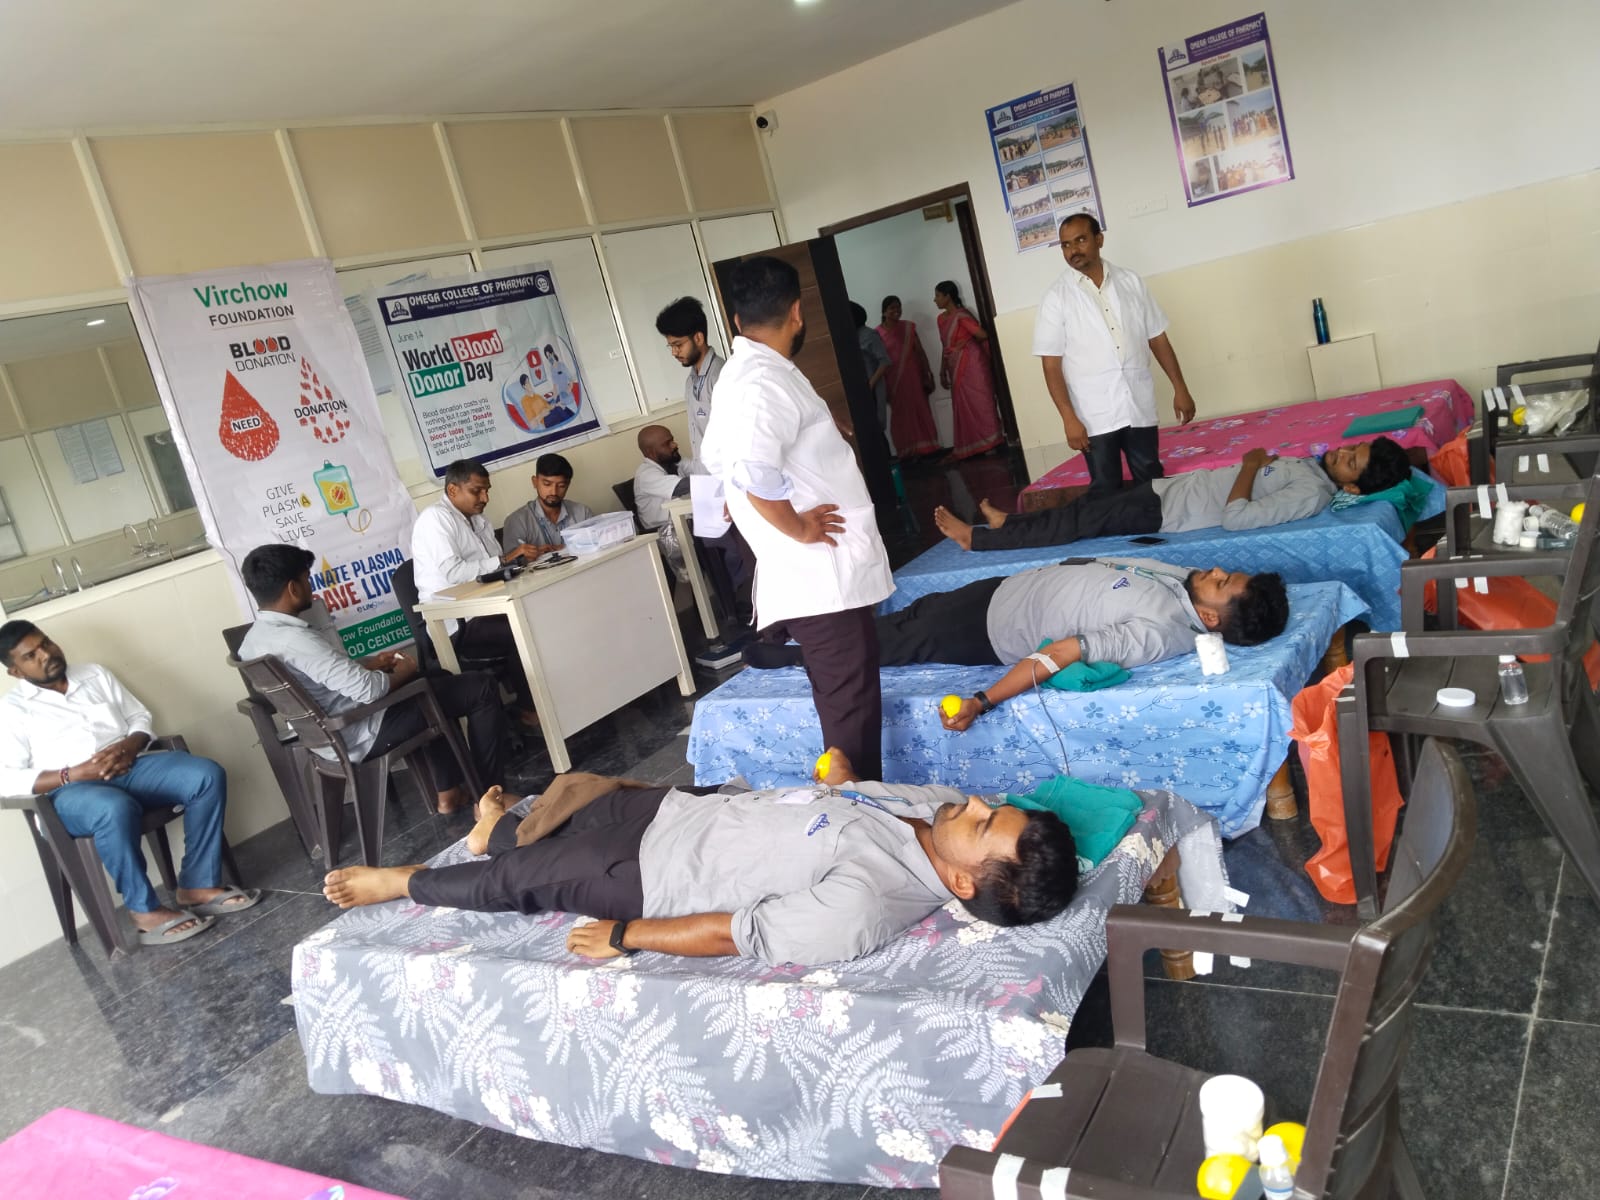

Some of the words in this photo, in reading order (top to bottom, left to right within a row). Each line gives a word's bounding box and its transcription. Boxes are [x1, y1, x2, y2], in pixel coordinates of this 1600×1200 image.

[193, 281, 288, 308] Virchow
[409, 292, 440, 306] OMEGA
[442, 286, 480, 300] COLLEGE
[482, 283, 493, 293] OF
[496, 276, 534, 291] PHARMACY
[209, 305, 294, 326] FOUNDATION
[398, 332, 414, 343] June
[415, 330, 424, 339] 14
[230, 336, 291, 359] BLOOD
[402, 342, 454, 371] World
[454, 333, 502, 362] Blood
[235, 352, 296, 372] DONATION
[410, 366, 462, 396] Donor
[465, 360, 494, 382] Day
[294, 400, 348, 419] DONATION
[422, 410, 438, 418] Blood
[472, 412, 492, 421] Donate
[232, 417, 261, 432] NEED
[266, 483, 296, 500] GIVE
[262, 494, 311, 518] PLASMA
[276, 512, 307, 528] SAVE
[278, 525, 315, 543] LIVES
[351, 548, 405, 578] PLASMA
[312, 582, 361, 613] AVE
[368, 626, 411, 650] CENTRE
